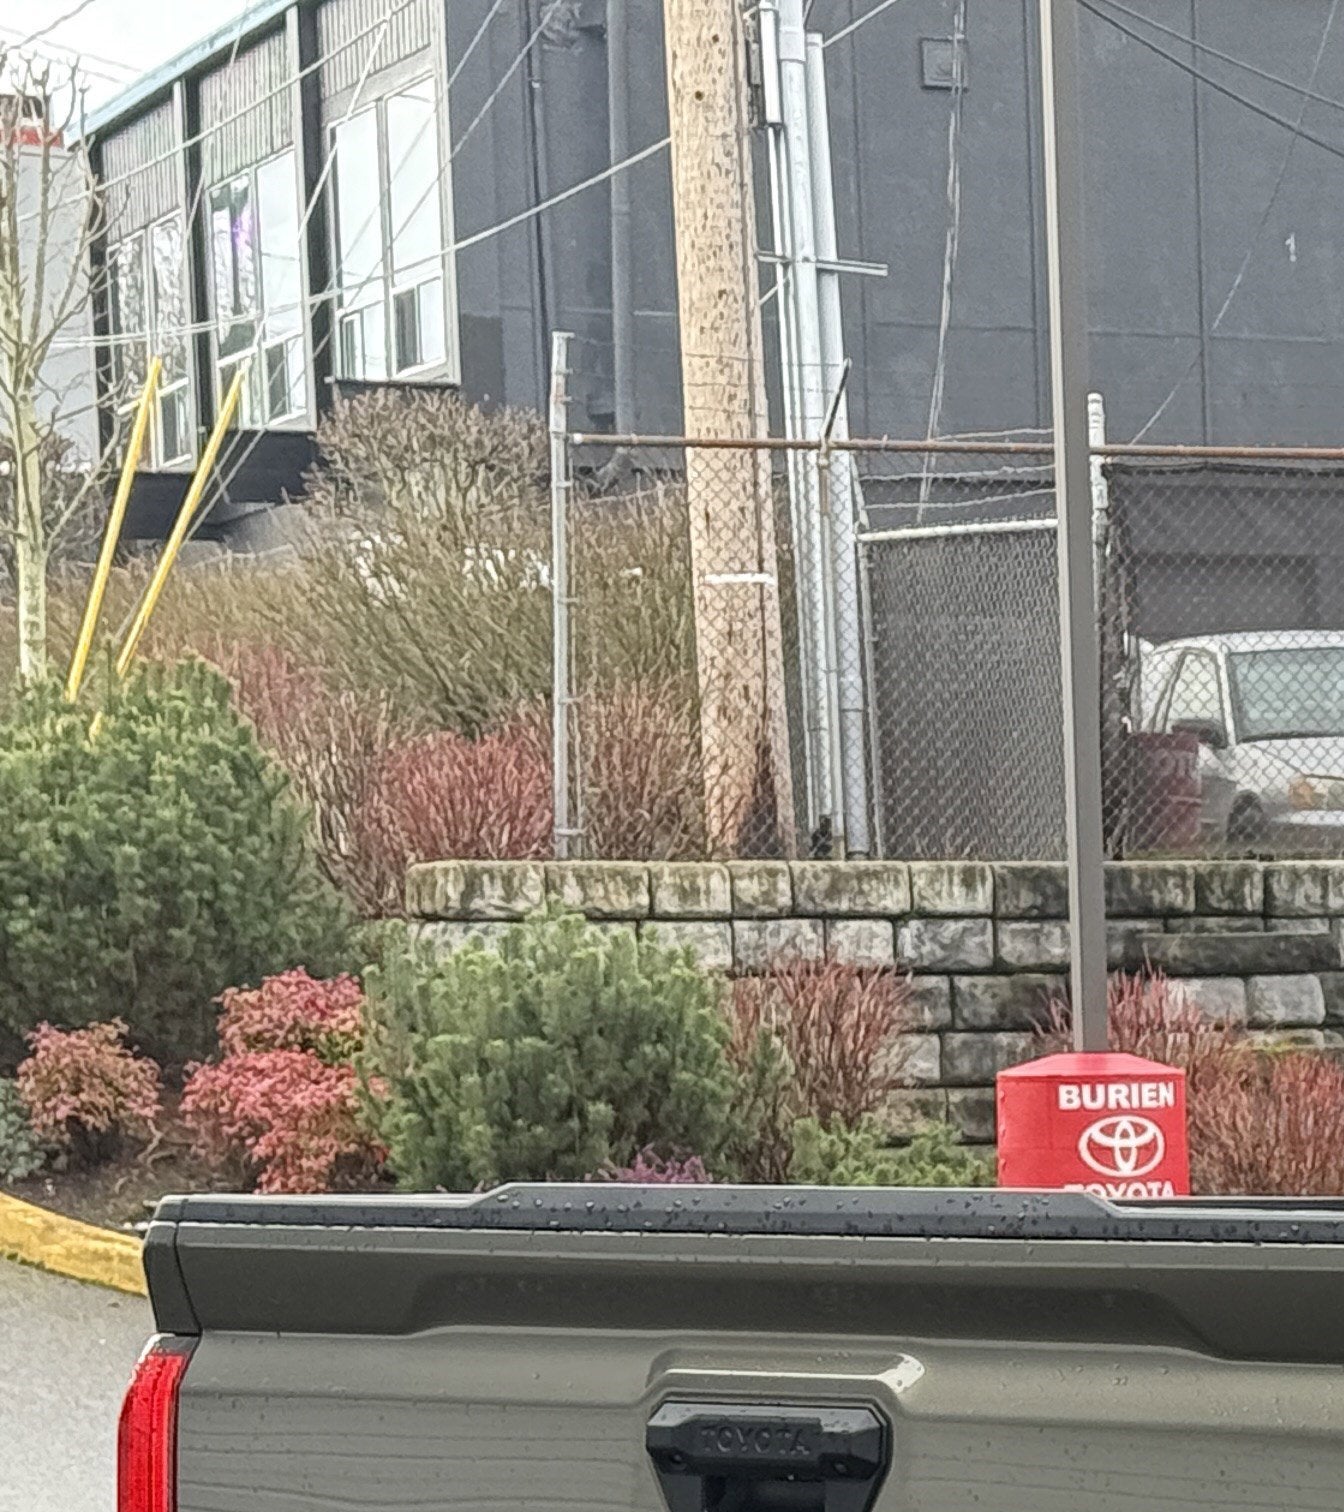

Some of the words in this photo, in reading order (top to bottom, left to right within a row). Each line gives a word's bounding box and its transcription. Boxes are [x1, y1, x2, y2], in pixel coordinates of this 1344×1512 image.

[1057, 1081, 1175, 1111] BURIEN
[1064, 1181, 1175, 1199] YOTA
[701, 1426, 810, 1456] TOYOTA
